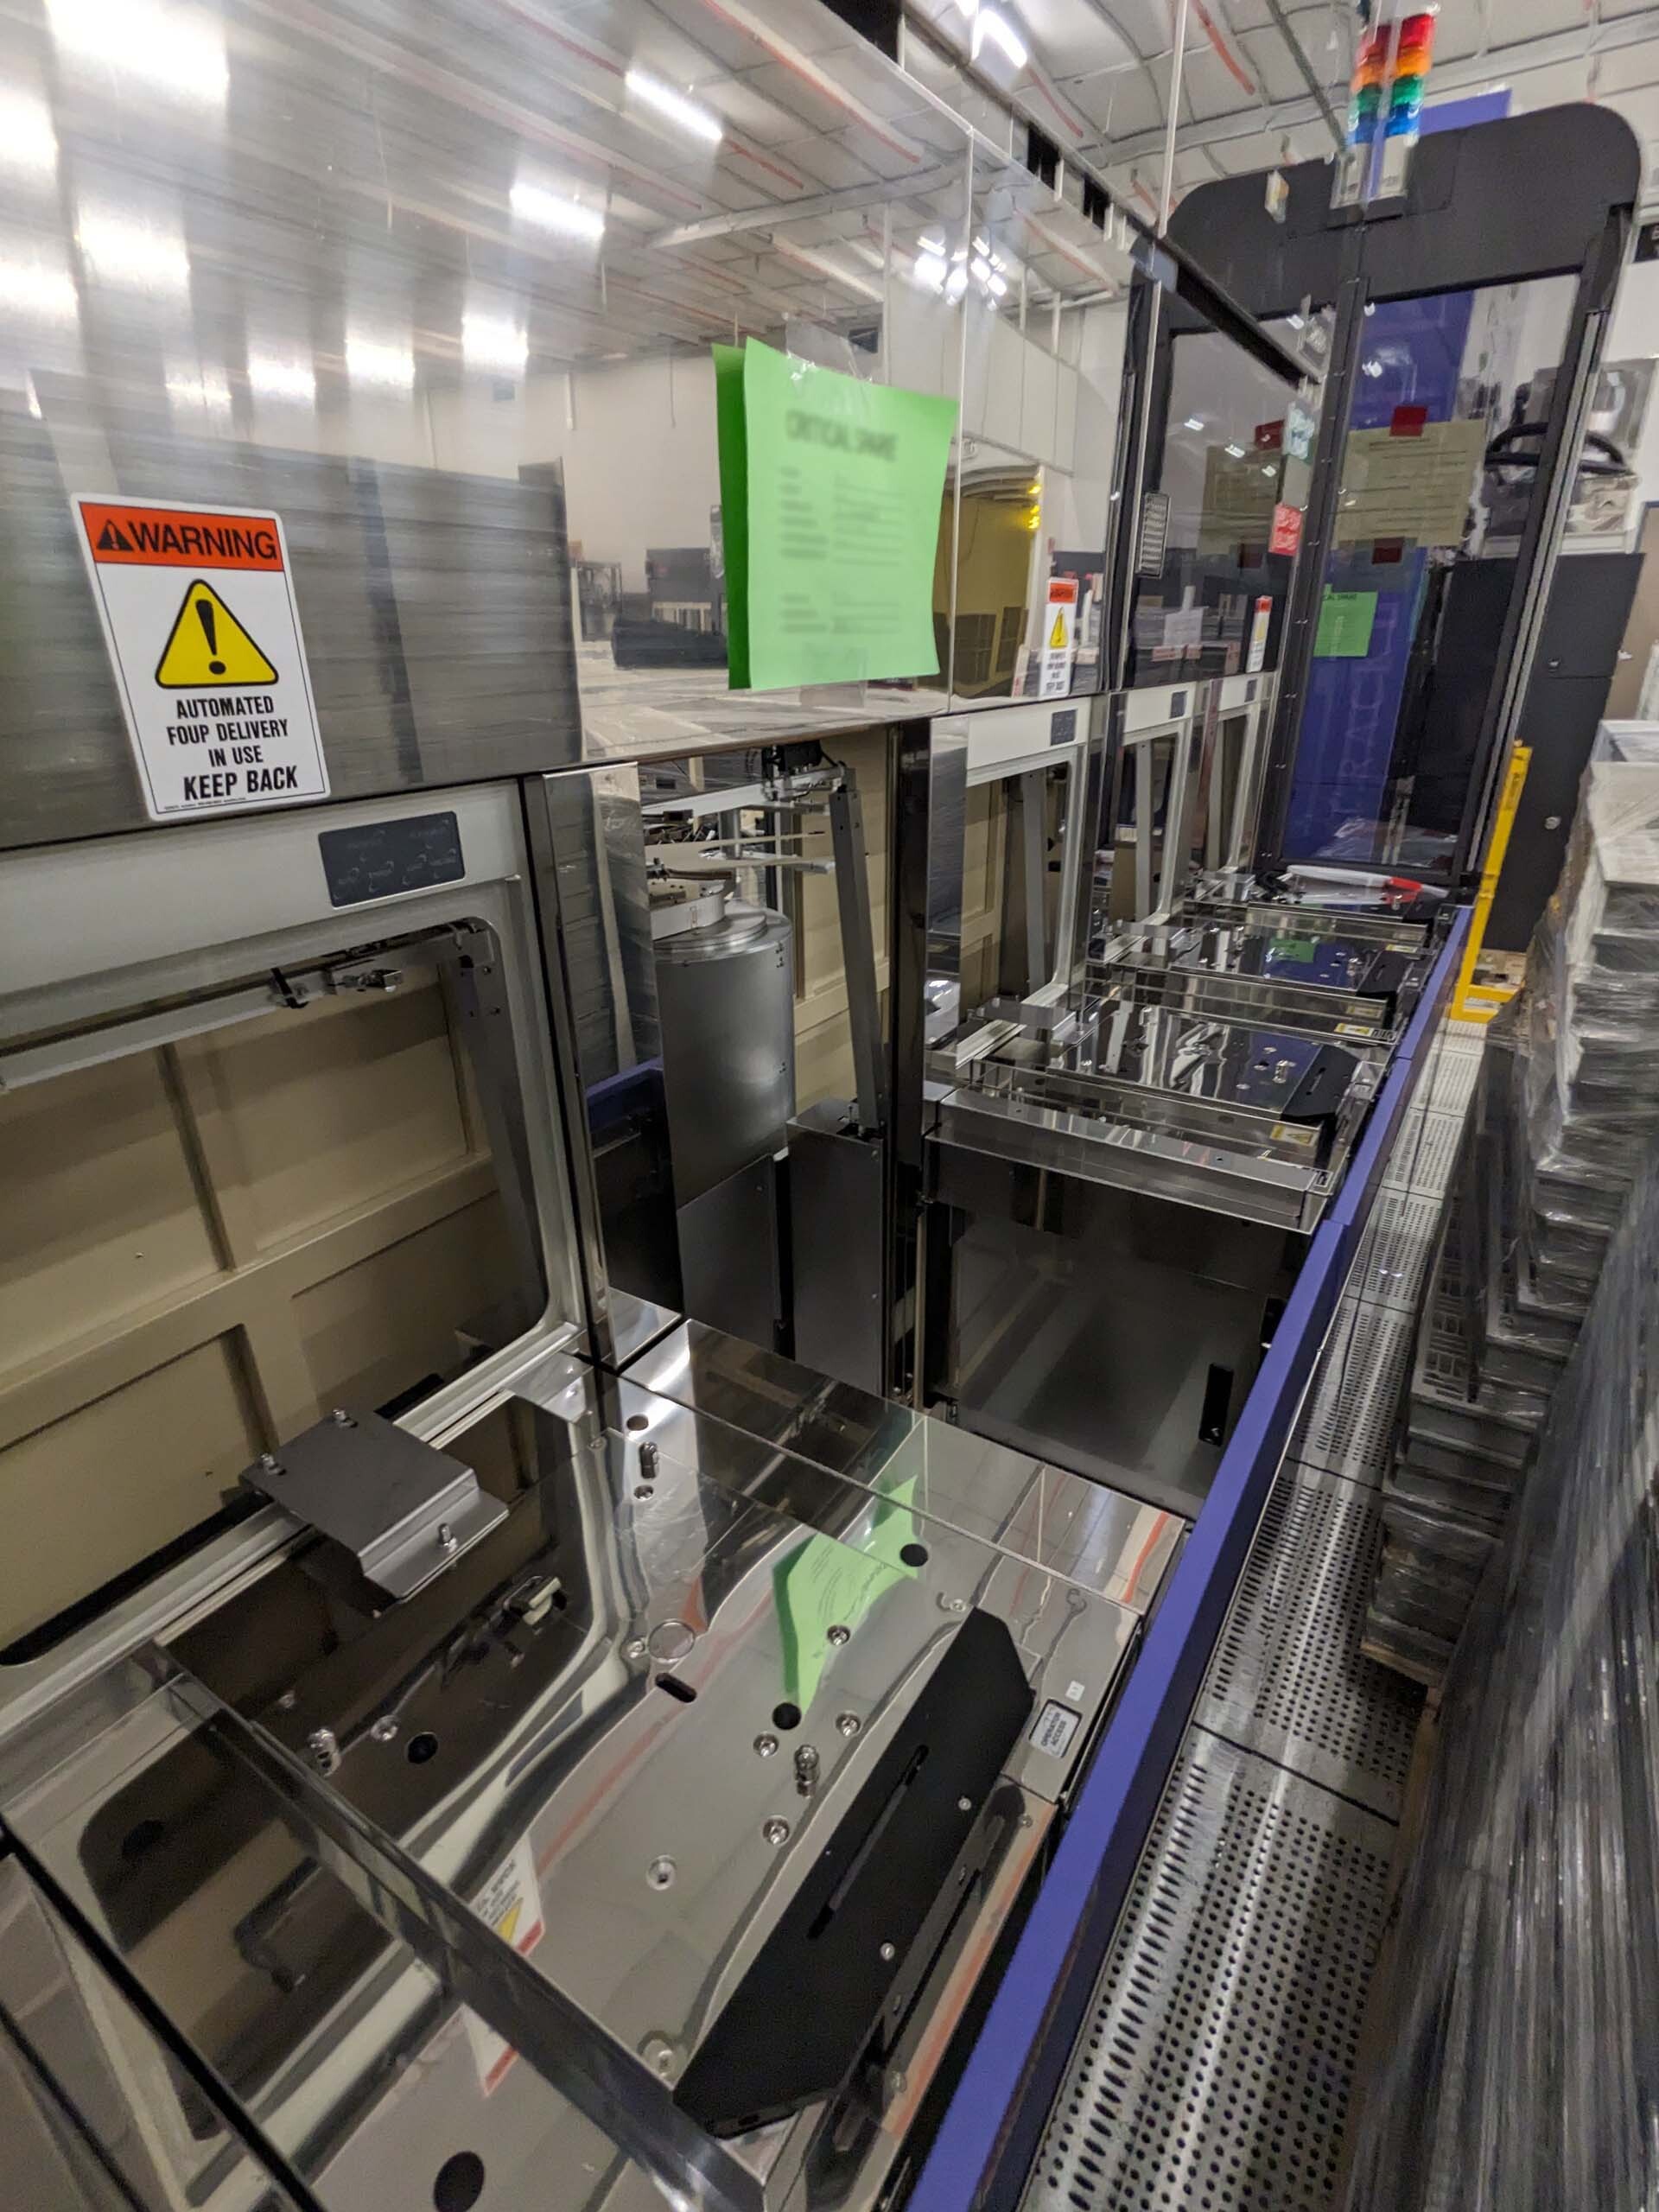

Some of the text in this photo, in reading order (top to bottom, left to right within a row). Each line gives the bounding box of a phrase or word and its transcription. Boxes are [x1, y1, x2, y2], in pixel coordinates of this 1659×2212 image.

[129, 523, 276, 560] WARNING
[176, 695, 275, 719] AUTOMATED
[167, 718, 289, 746] FOUP DELIVERY
[208, 745, 264, 768] IN USE
[184, 766, 298, 801] KEEP BACK
